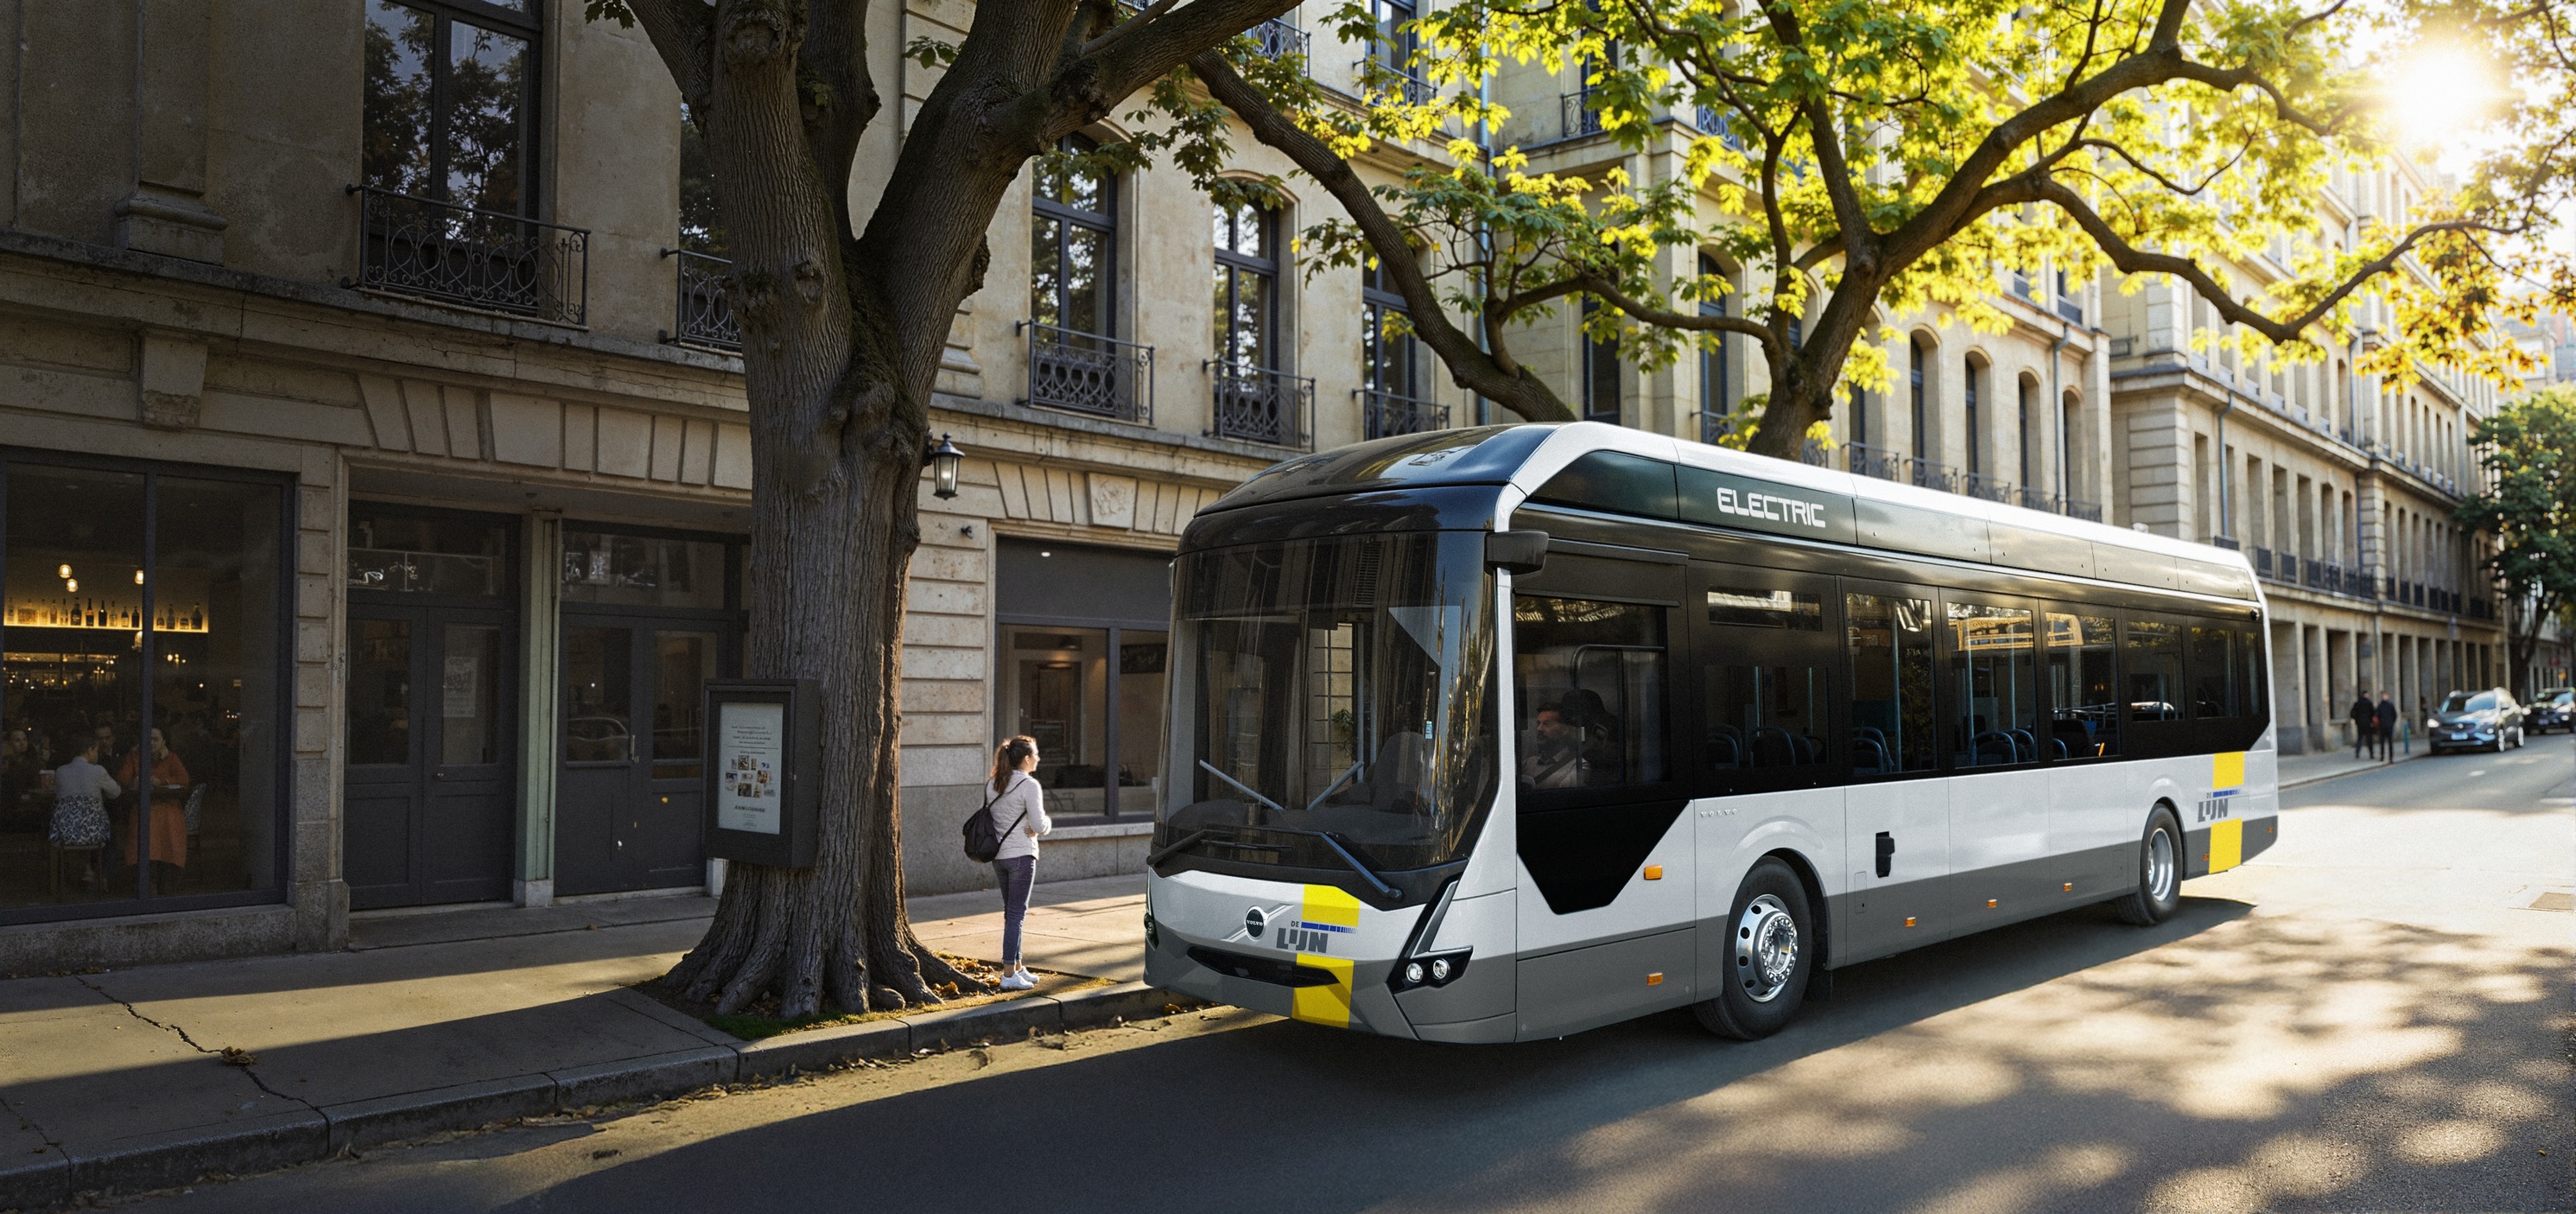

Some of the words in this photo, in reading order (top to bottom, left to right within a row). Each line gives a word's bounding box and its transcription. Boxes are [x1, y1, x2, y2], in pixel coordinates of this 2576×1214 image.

[1716, 486, 1826, 528] ELECTRIC
[1700, 808, 1737, 817] VOLVO
[2198, 798, 2229, 823] LIJN
[1276, 927, 1329, 954] LIJN
